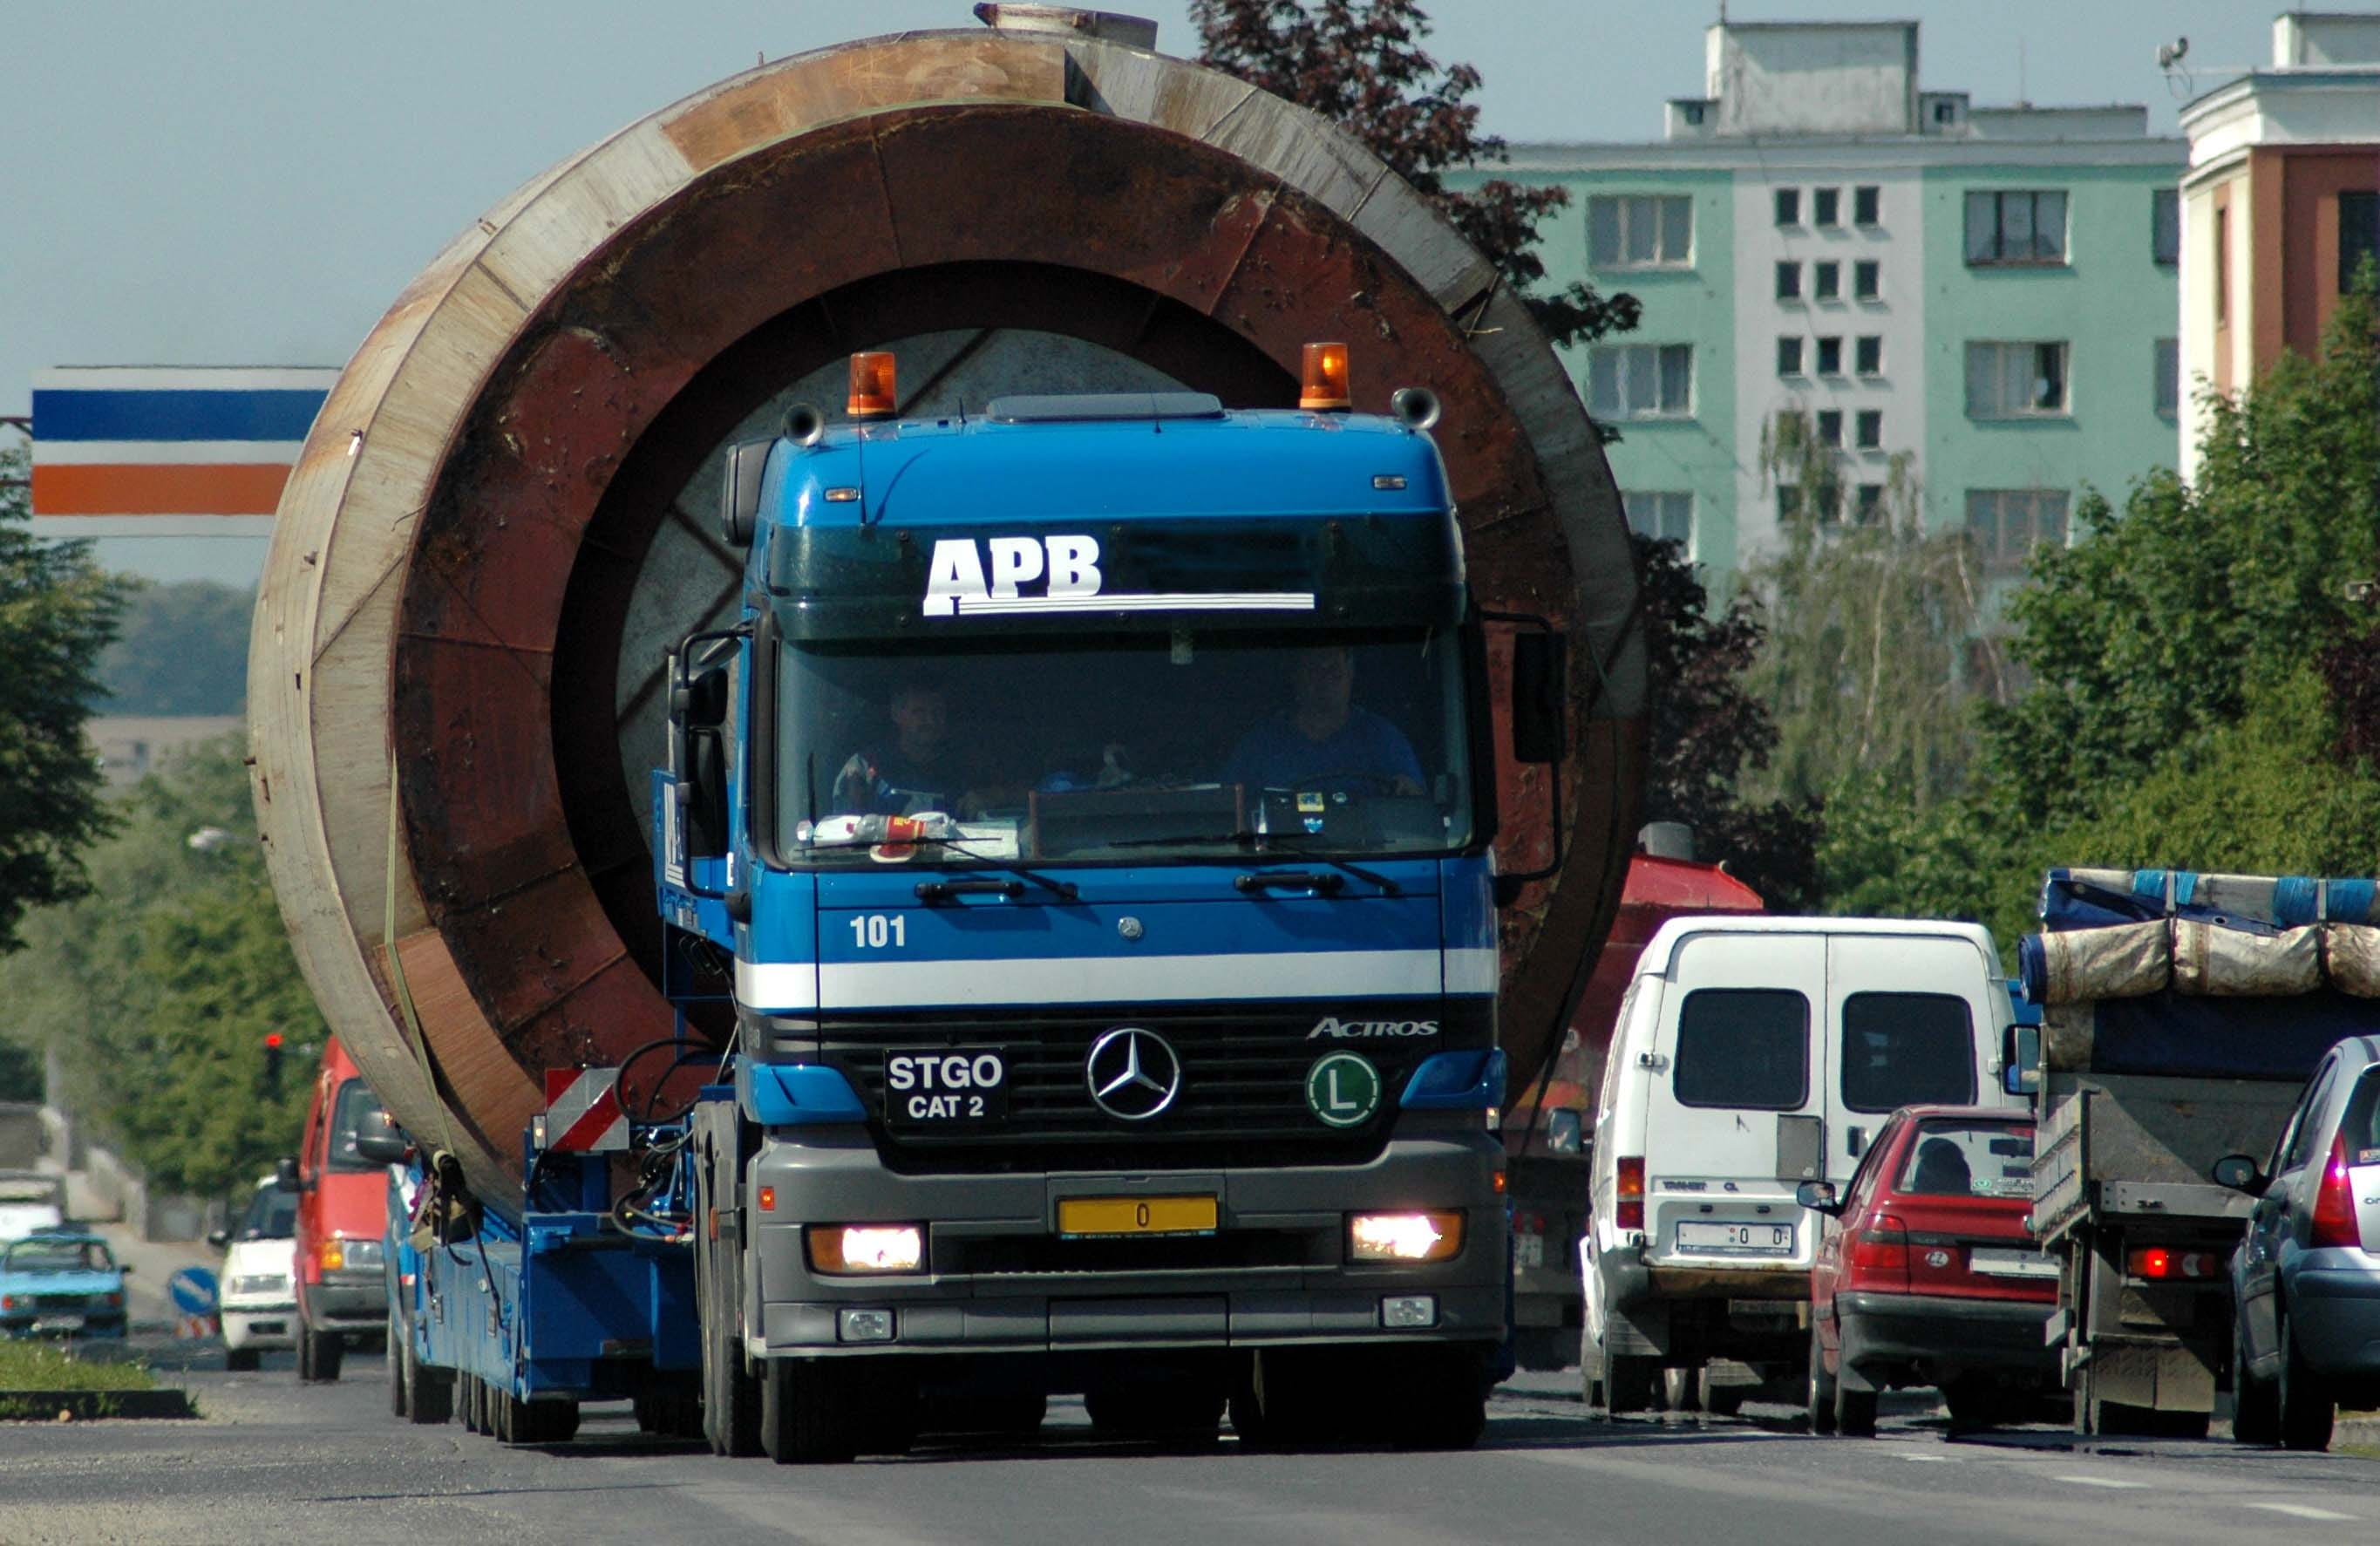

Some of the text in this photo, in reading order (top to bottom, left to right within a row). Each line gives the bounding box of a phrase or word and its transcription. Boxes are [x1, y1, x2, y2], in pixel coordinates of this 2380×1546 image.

[923, 535, 1102, 616] APB
[850, 915, 905, 948] 101
[889, 1055, 1003, 1089] STGO
[1329, 1069, 1357, 1109] L
[908, 1096, 983, 1118] CAT 2
[1137, 1202, 1150, 1227] 0
